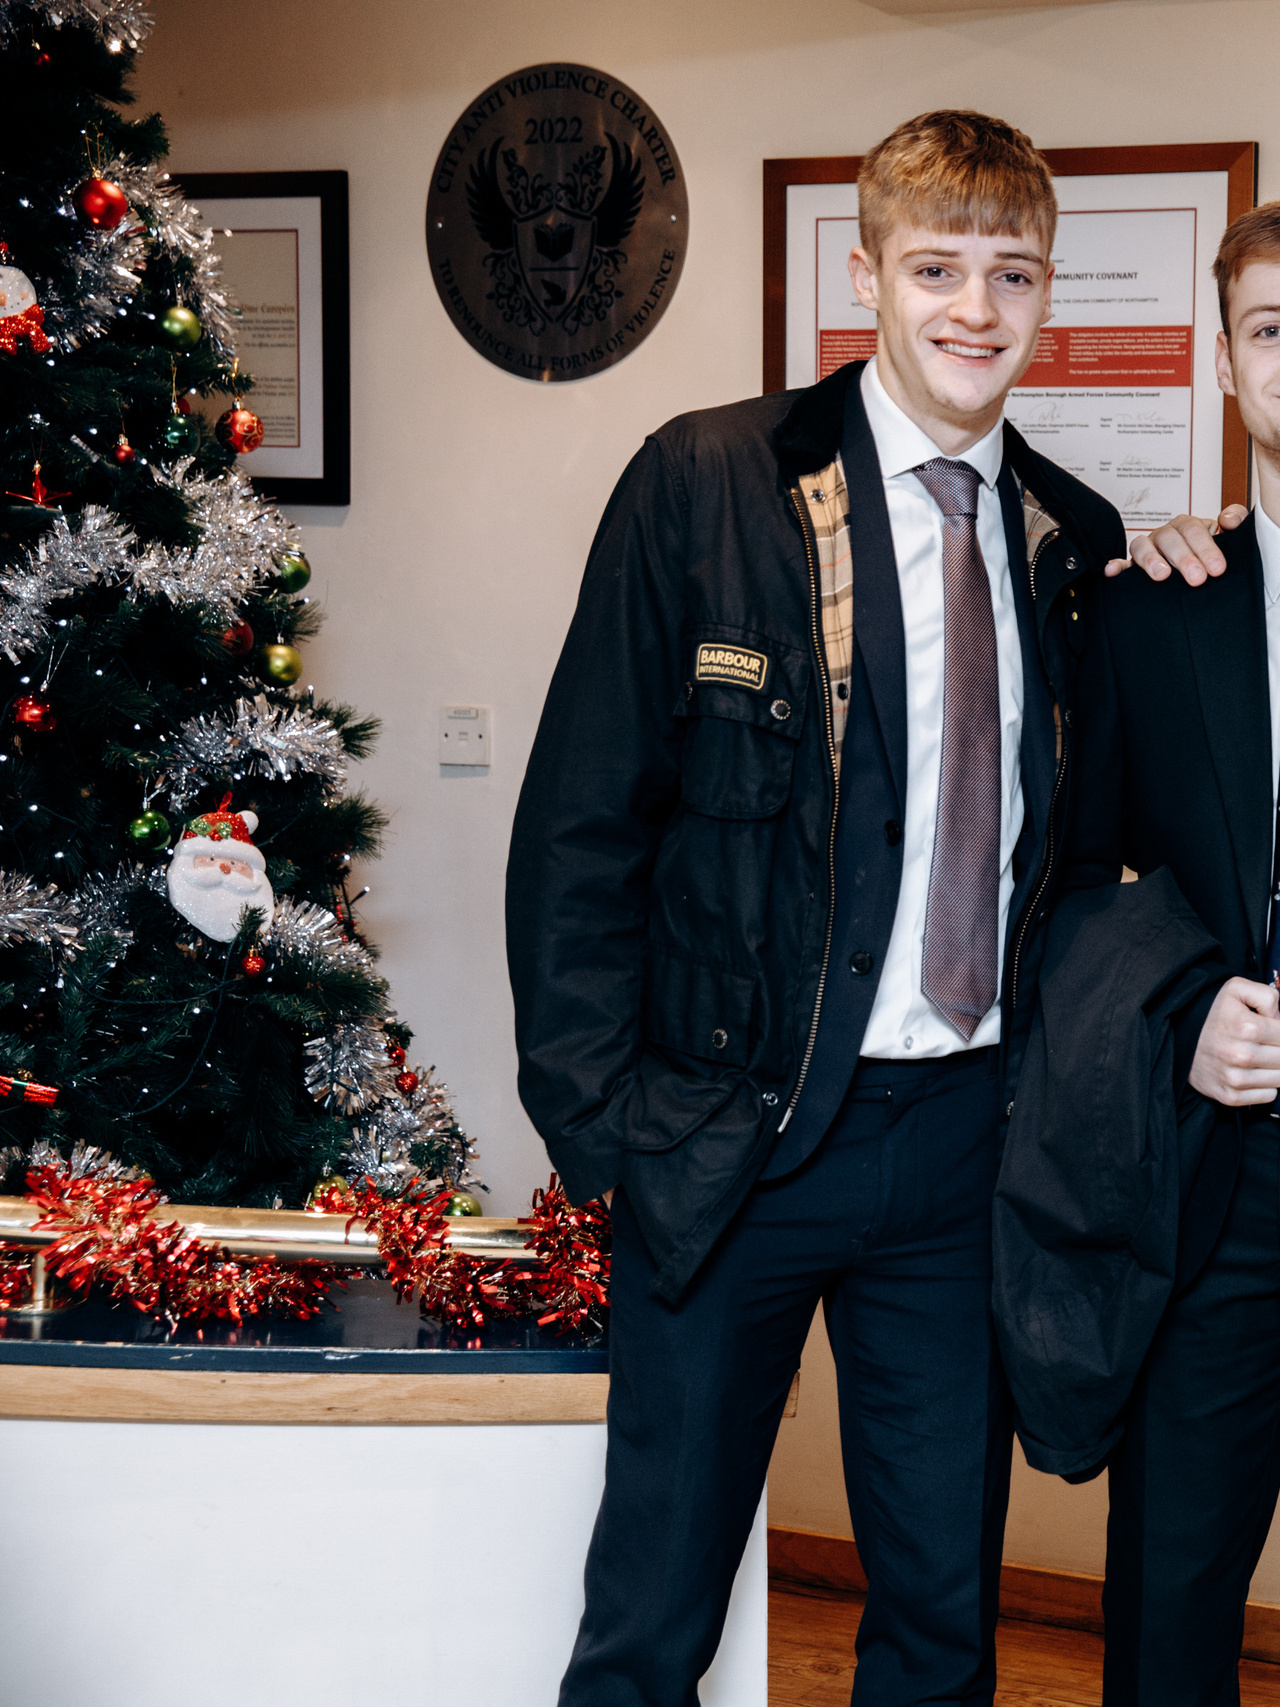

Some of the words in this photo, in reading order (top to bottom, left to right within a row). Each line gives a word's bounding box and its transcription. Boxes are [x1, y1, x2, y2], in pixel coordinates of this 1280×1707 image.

[437, 141, 467, 193] CITY
[462, 95, 508, 139] ANTI
[504, 70, 609, 100] VIOLENCE
[610, 89, 677, 187] CHARTER
[525, 116, 584, 145] 2022
[1096, 272, 1138, 281] COVENANT
[438, 259, 455, 286] TO
[448, 285, 513, 361] RENOUNCE
[517, 352, 546, 370] ALL
[551, 346, 605, 372] FORMS
[606, 332, 627, 354] OF
[622, 248, 677, 337] VIOLENCE
[699, 665, 760, 683] INTERNATIONAL
[700, 650, 761, 673] BARBOUR
